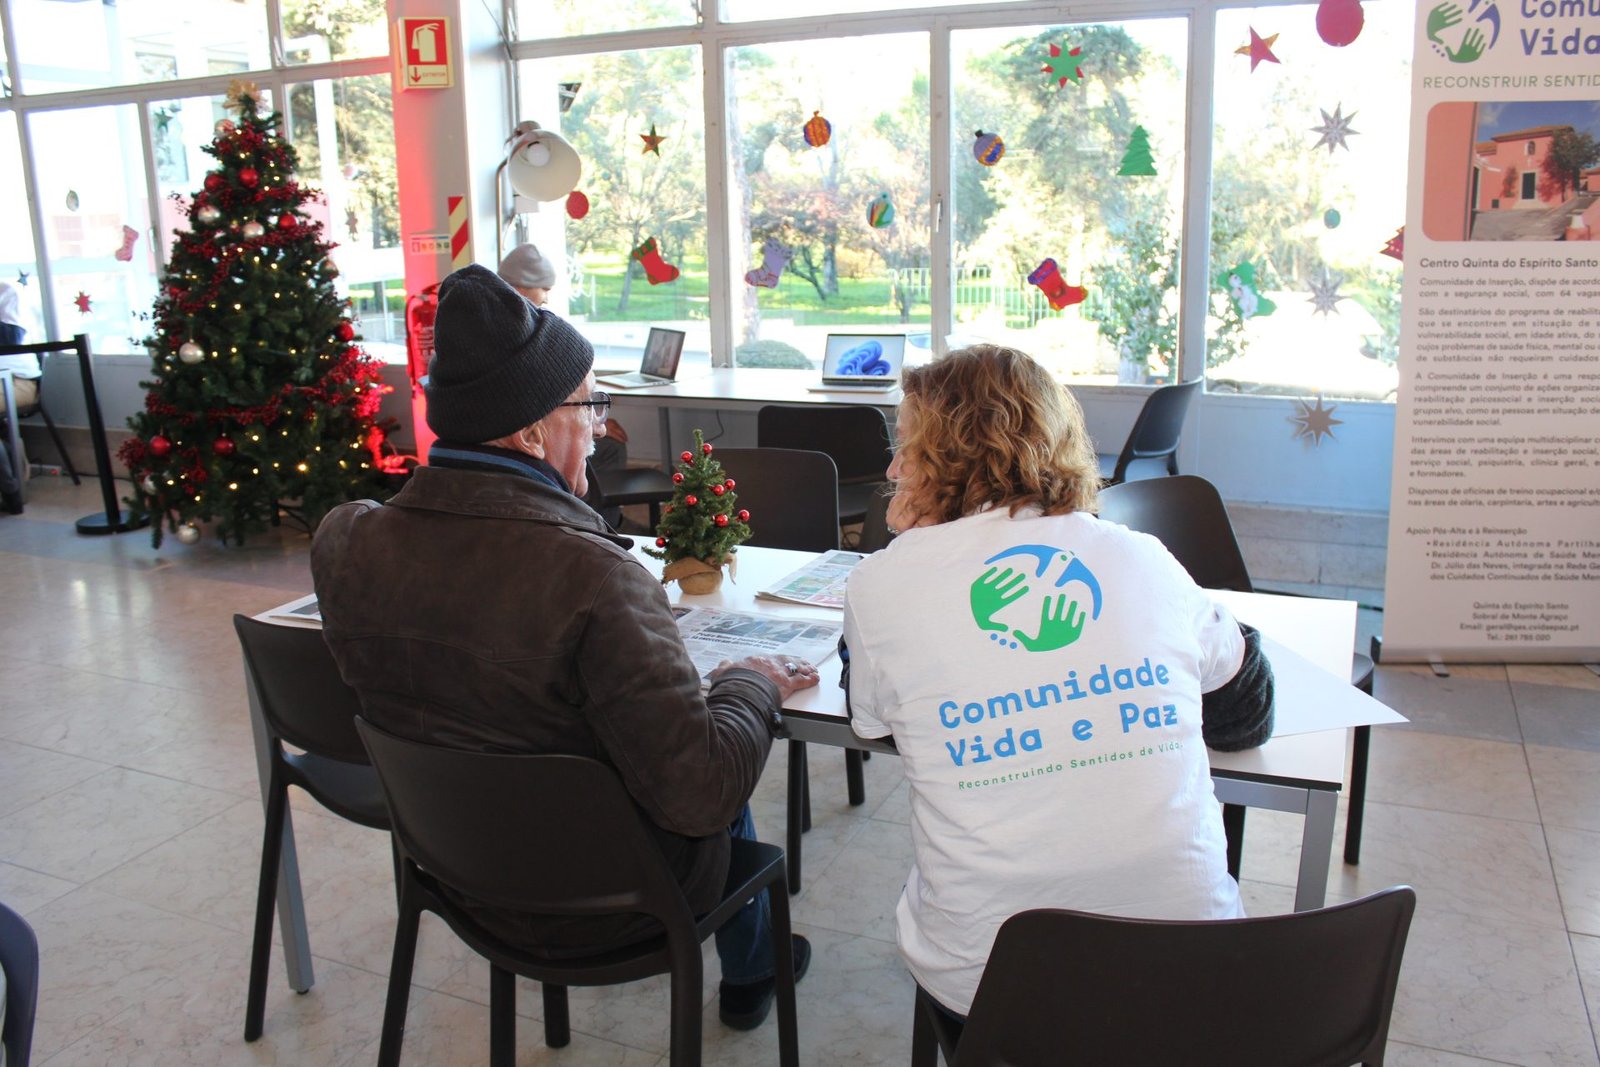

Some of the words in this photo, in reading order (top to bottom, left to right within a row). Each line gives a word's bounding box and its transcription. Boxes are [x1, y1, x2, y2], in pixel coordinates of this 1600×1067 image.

[1520, 28, 1600, 56] Vida
[1423, 76, 1538, 88] RECONSTRUIR
[1420, 258, 1459, 268] Centro
[1462, 258, 1498, 268] Quinta
[1502, 258, 1516, 268] do
[1520, 258, 1561, 269] Espírito
[1566, 258, 1598, 268] Santo
[1489, 278, 1526, 287] Inserção,
[1528, 278, 1556, 287] dispõe
[1503, 290, 1529, 298] social,
[1532, 320, 1572, 328] situação
[1510, 355, 1553, 363] requeiram
[1502, 373, 1538, 381] Inserção
[939, 658, 1169, 728] Comunidade
[945, 728, 1042, 766] Vida
[1072, 719, 1093, 741] e
[1119, 703, 1177, 733] Paz
[958, 763, 1063, 790] Reconstruindo
[1070, 752, 1133, 768] Sentidos
[1140, 747, 1153, 756] de
